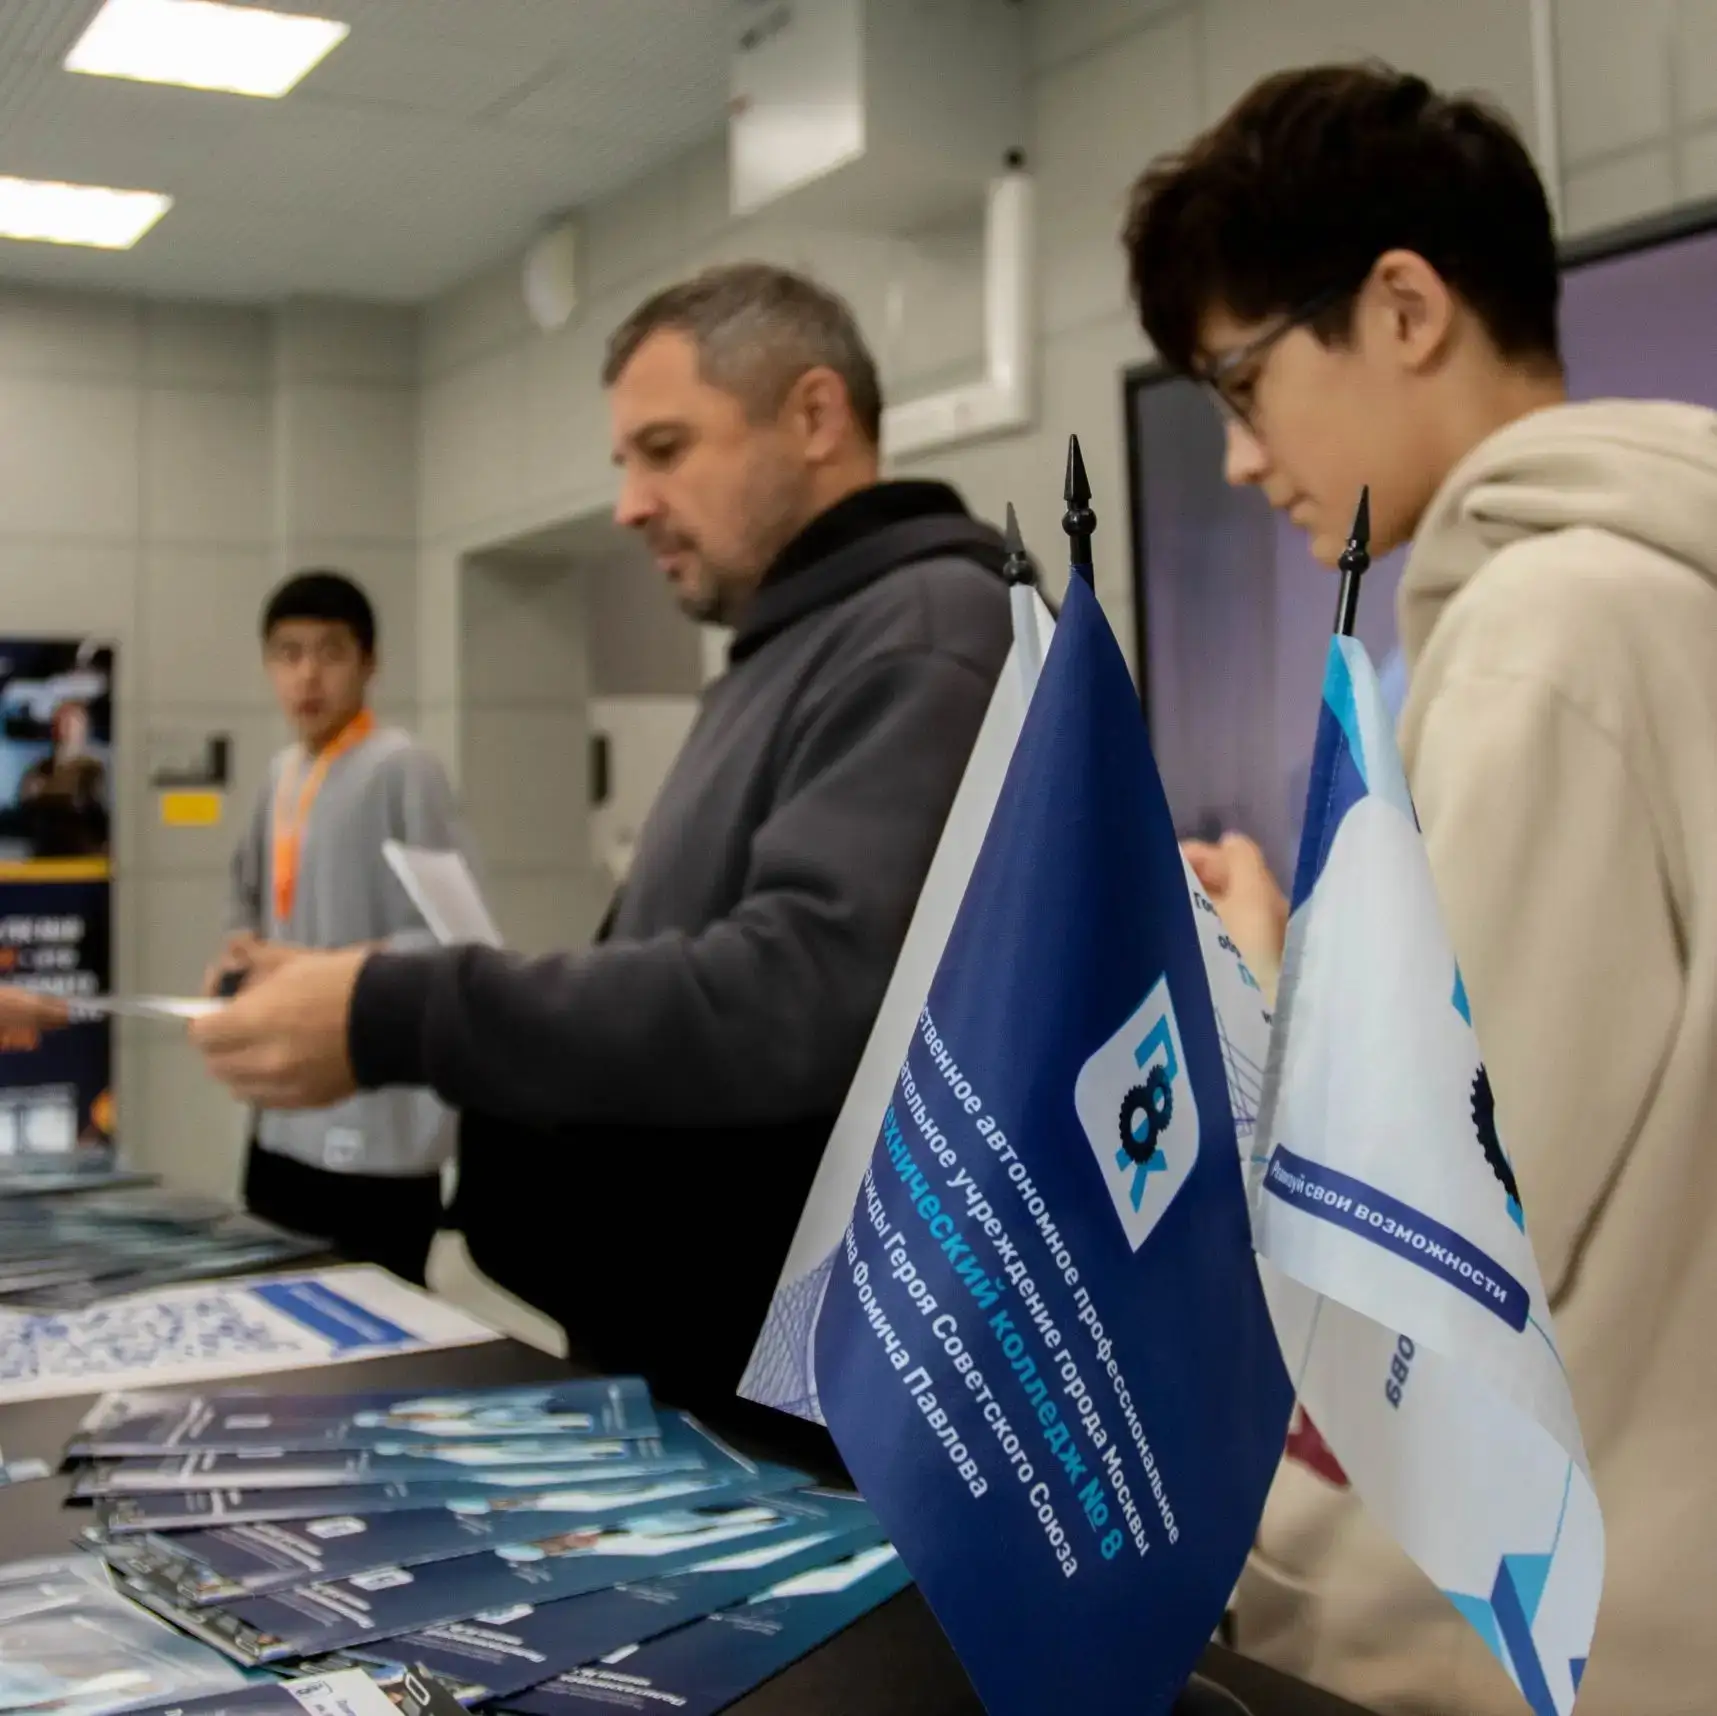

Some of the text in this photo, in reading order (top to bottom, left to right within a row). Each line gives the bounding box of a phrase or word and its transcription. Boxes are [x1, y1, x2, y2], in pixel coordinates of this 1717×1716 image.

[853, 1260, 910, 1371] Фомича
[902, 1366, 988, 1499] Павлова
[945, 1167, 1062, 1348] учреждение
[1054, 1347, 1108, 1449] города
[1102, 1444, 1151, 1557] Москвы
[975, 1115, 1080, 1286] автономное
[1072, 1286, 1180, 1545] профессиональное
[1304, 1182, 1353, 1213] свои
[1354, 1203, 1508, 1304] возможности
[883, 1230, 939, 1316] Героя
[932, 1313, 1034, 1484] Советского
[1029, 1482, 1079, 1579] Союза
[988, 1309, 1088, 1486] колледж
[1077, 1476, 1109, 1533] №
[1101, 1528, 1124, 1560] 8
